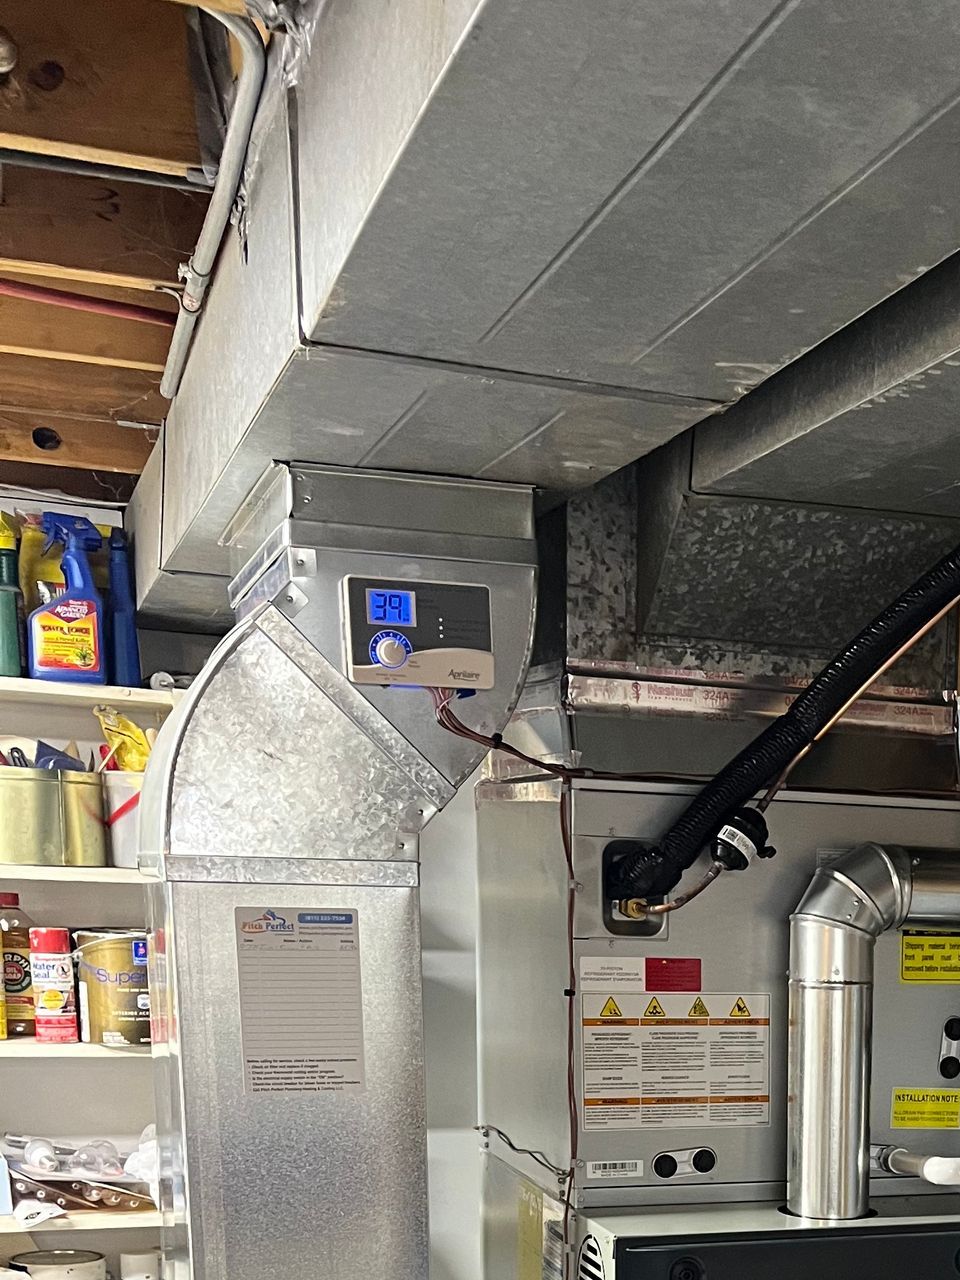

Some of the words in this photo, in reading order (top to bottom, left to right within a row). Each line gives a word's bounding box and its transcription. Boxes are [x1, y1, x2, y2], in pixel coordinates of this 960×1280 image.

[373, 593, 402, 621] 39
[703, 689, 729, 701] 324A
[893, 705, 918, 716] 324A
[242, 922, 263, 930] Pitch
[33, 963, 55, 971] Water
[33, 970, 50, 979] Seal
[895, 1094, 940, 1102] INSTALLATION
[942, 1094, 959, 1102] NOTE
